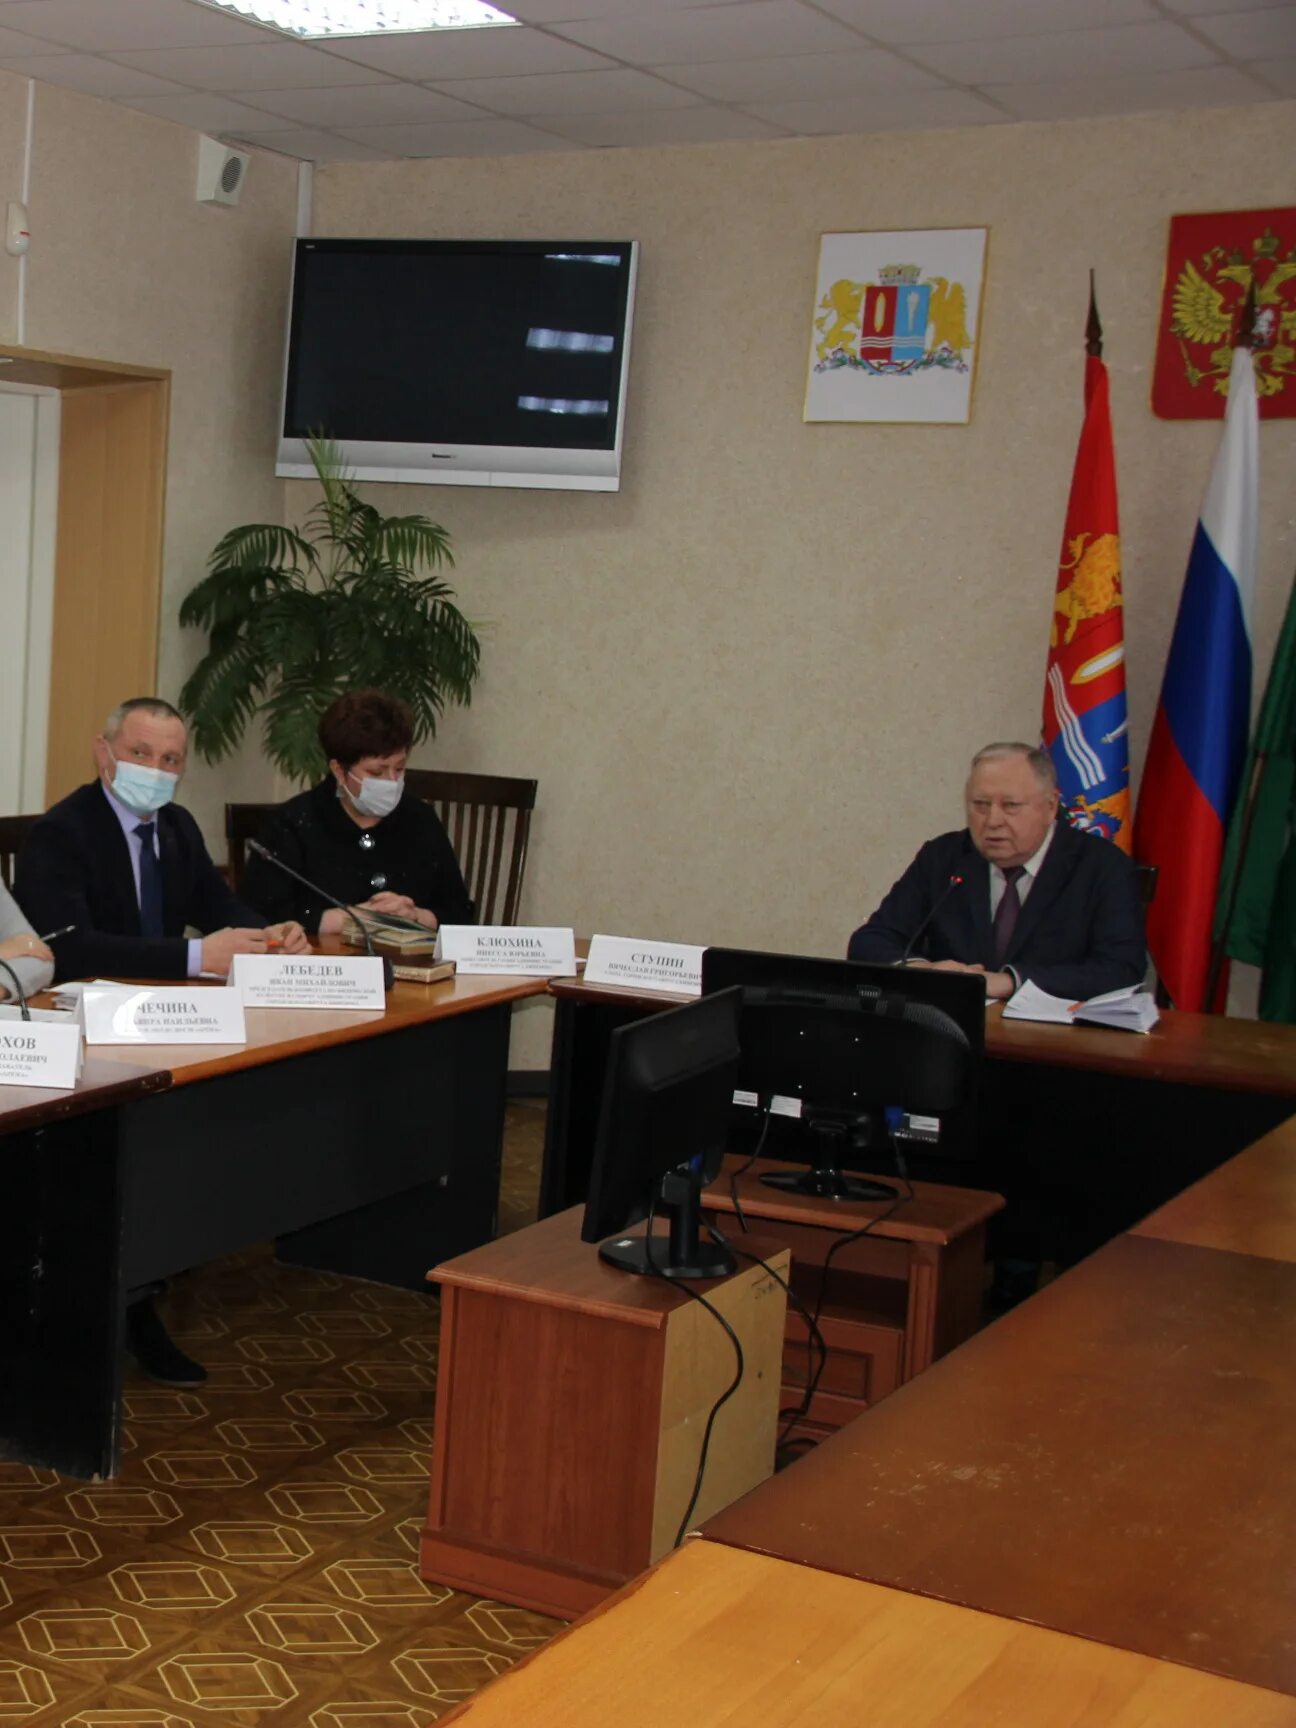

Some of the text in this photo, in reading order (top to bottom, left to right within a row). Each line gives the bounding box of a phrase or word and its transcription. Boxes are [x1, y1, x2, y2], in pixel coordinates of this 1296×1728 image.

[477, 937, 543, 948] КЛЮХИНА
[631, 953, 684, 968] СТУПИН
[280, 965, 343, 976] ЛЕБЕДЕВ
